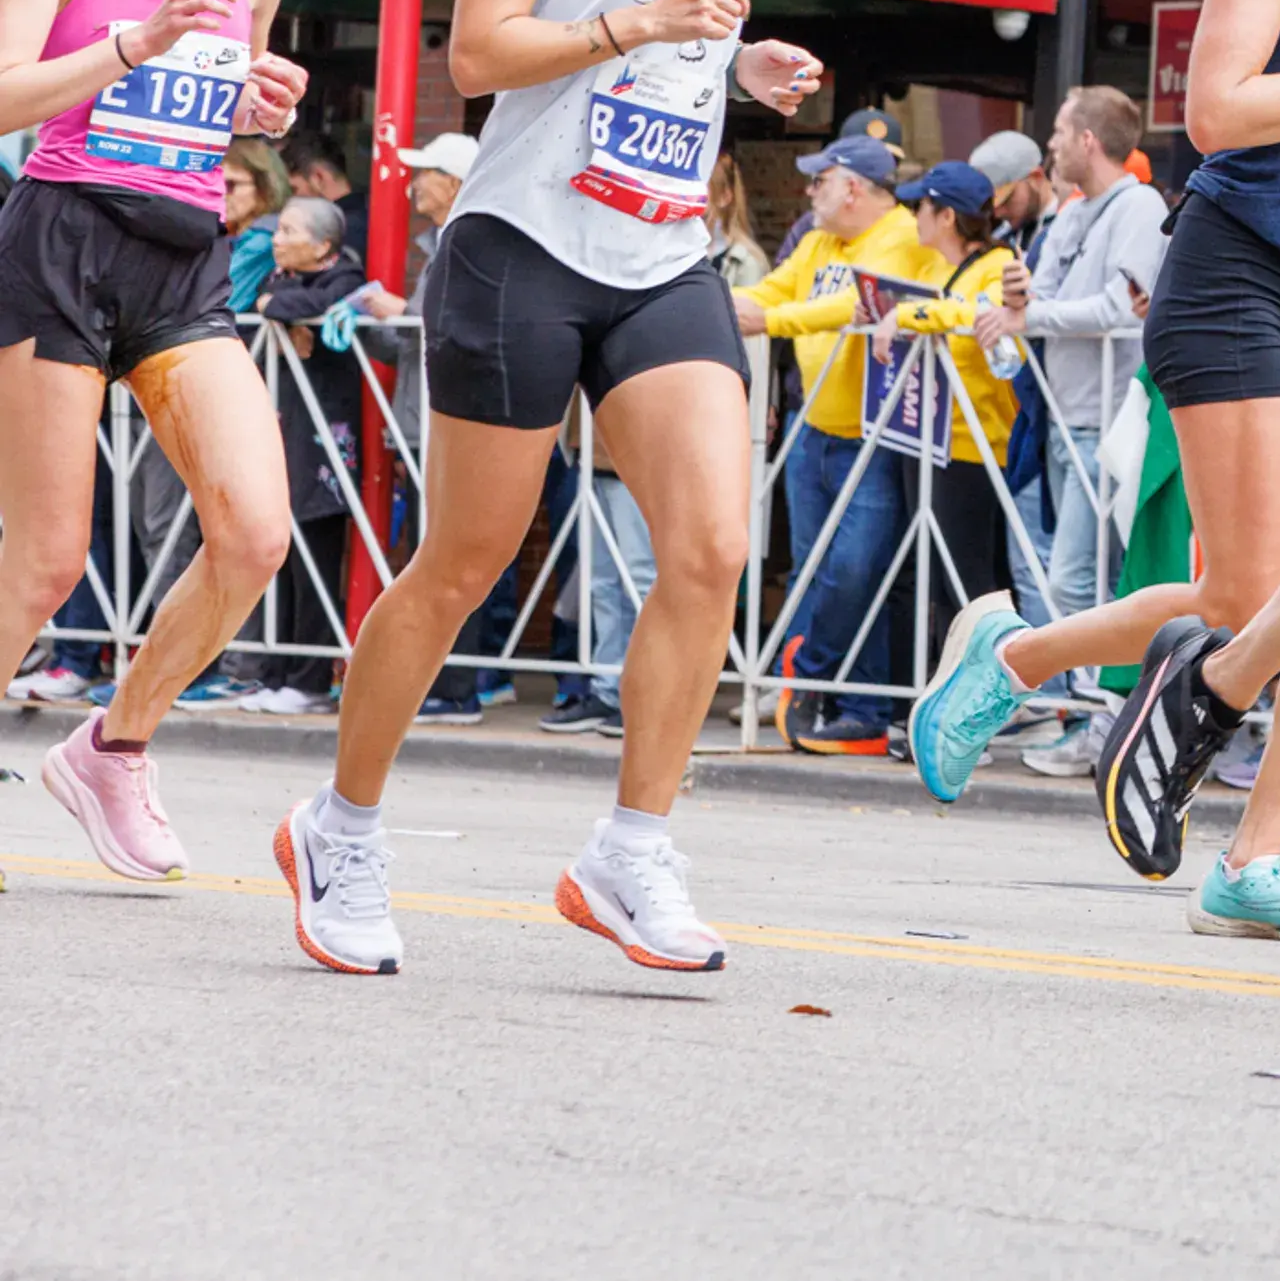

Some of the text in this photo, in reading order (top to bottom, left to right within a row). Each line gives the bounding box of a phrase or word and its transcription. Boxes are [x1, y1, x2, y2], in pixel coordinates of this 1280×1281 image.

[150, 71, 237, 125] 1912
[590, 102, 707, 171] B 20367
